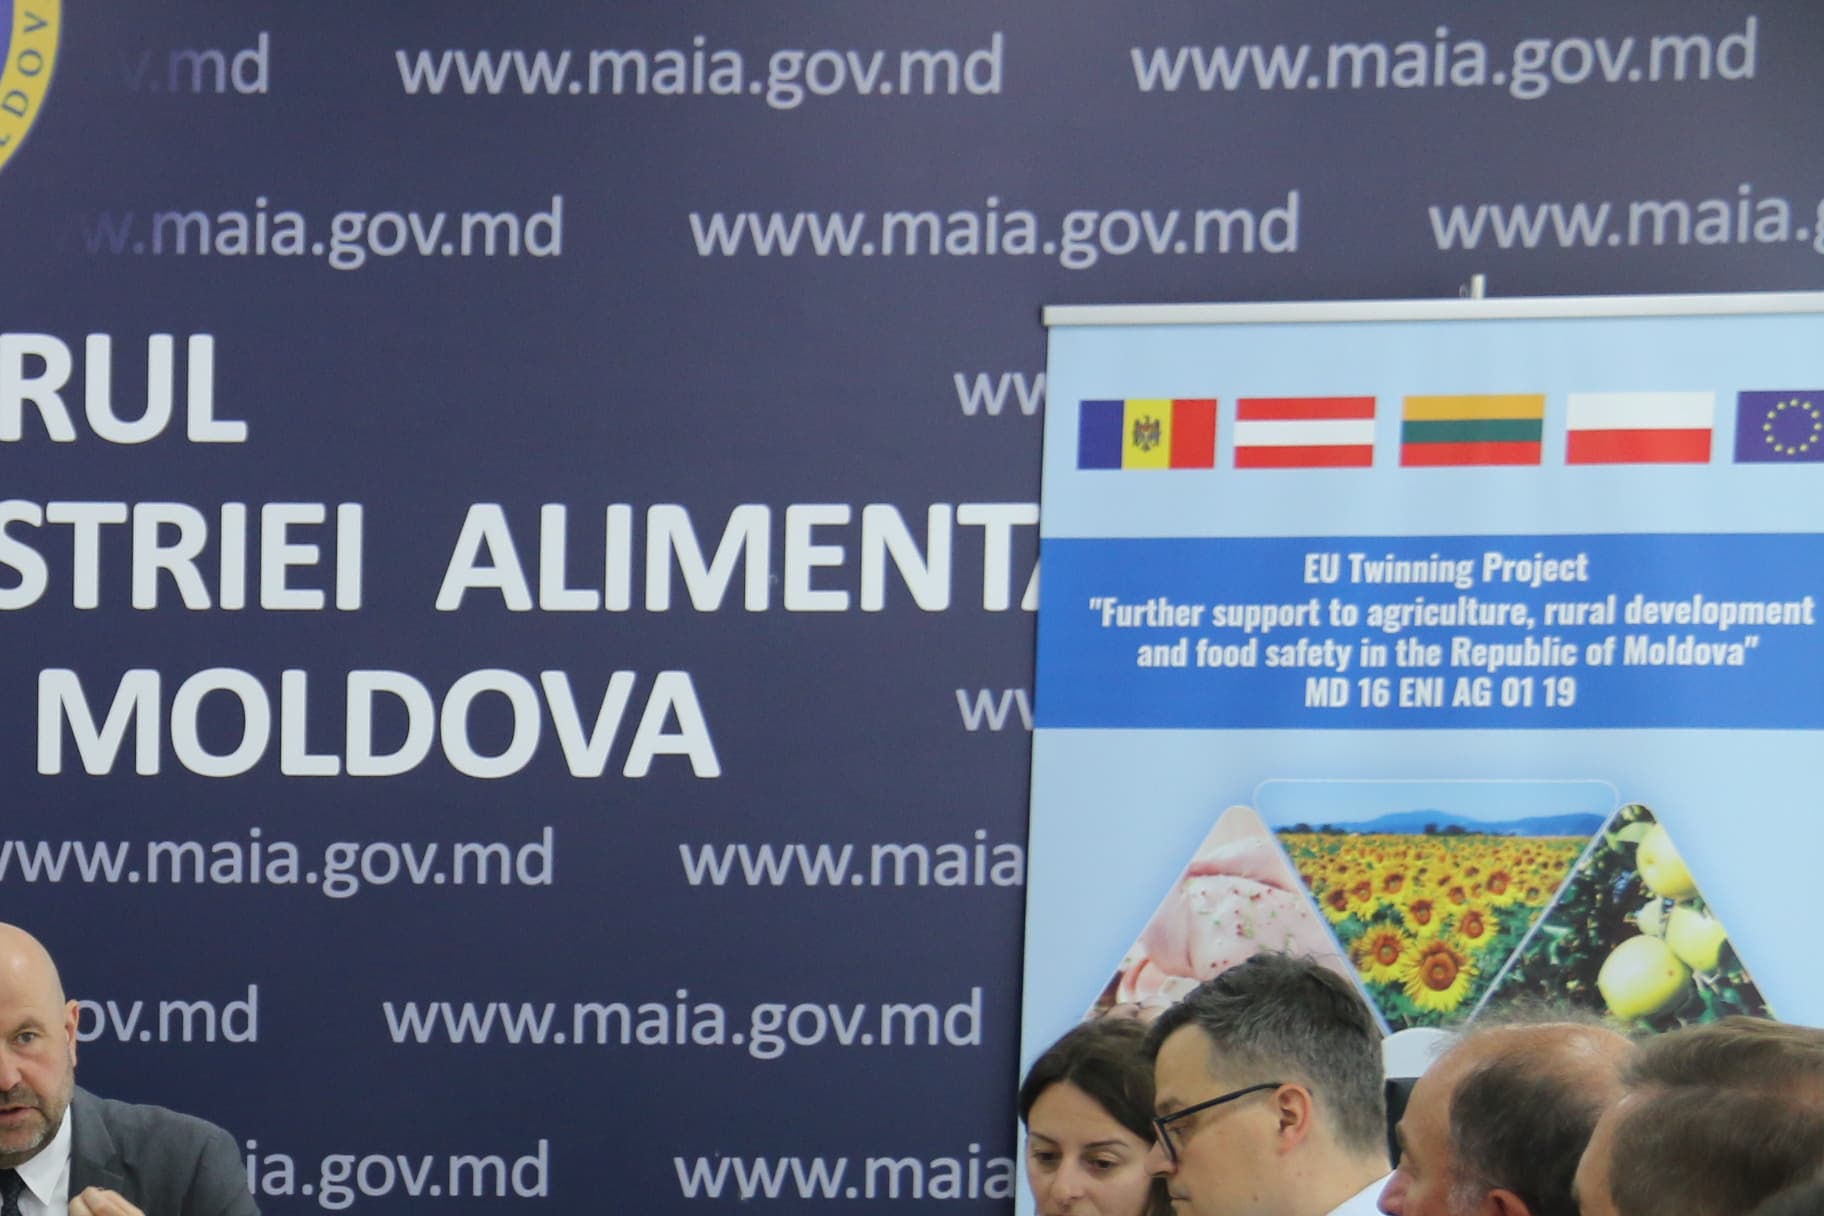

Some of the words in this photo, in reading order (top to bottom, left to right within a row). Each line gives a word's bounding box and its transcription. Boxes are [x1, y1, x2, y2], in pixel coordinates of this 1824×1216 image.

[395, 31, 1004, 110] www.maia.gov.md
[1130, 15, 1757, 100] www.maia.gov.md
[689, 190, 1300, 270] www.maia.gov.md
[1428, 183, 1824, 255] www.maia.
[435, 502, 1039, 612] ALIMENT
[1305, 553, 1340, 583] EU
[1348, 553, 1474, 589] Twinning
[1482, 552, 1589, 588] Project
[1212, 598, 1321, 634] support
[1328, 598, 1359, 627] to
[1366, 596, 1535, 634] agriculture,
[1544, 594, 1617, 626] rural
[1625, 594, 1815, 631] development
[1137, 637, 1188, 667] and
[1196, 637, 1257, 667] food
[1265, 637, 1353, 673] safety
[1360, 638, 1387, 667] in
[1395, 637, 1441, 667] the
[1451, 636, 1577, 673] Republic
[1586, 636, 1617, 666] of
[37, 667, 722, 779] MOLDOVA
[1305, 677, 1349, 707] MD
[1358, 677, 1390, 708] 16
[1400, 677, 1443, 707] ENI
[1452, 677, 1492, 707] AG
[1501, 677, 1533, 707] 01
[1543, 676, 1576, 707] 19
[382, 986, 983, 1060] www.maia.gov.md
